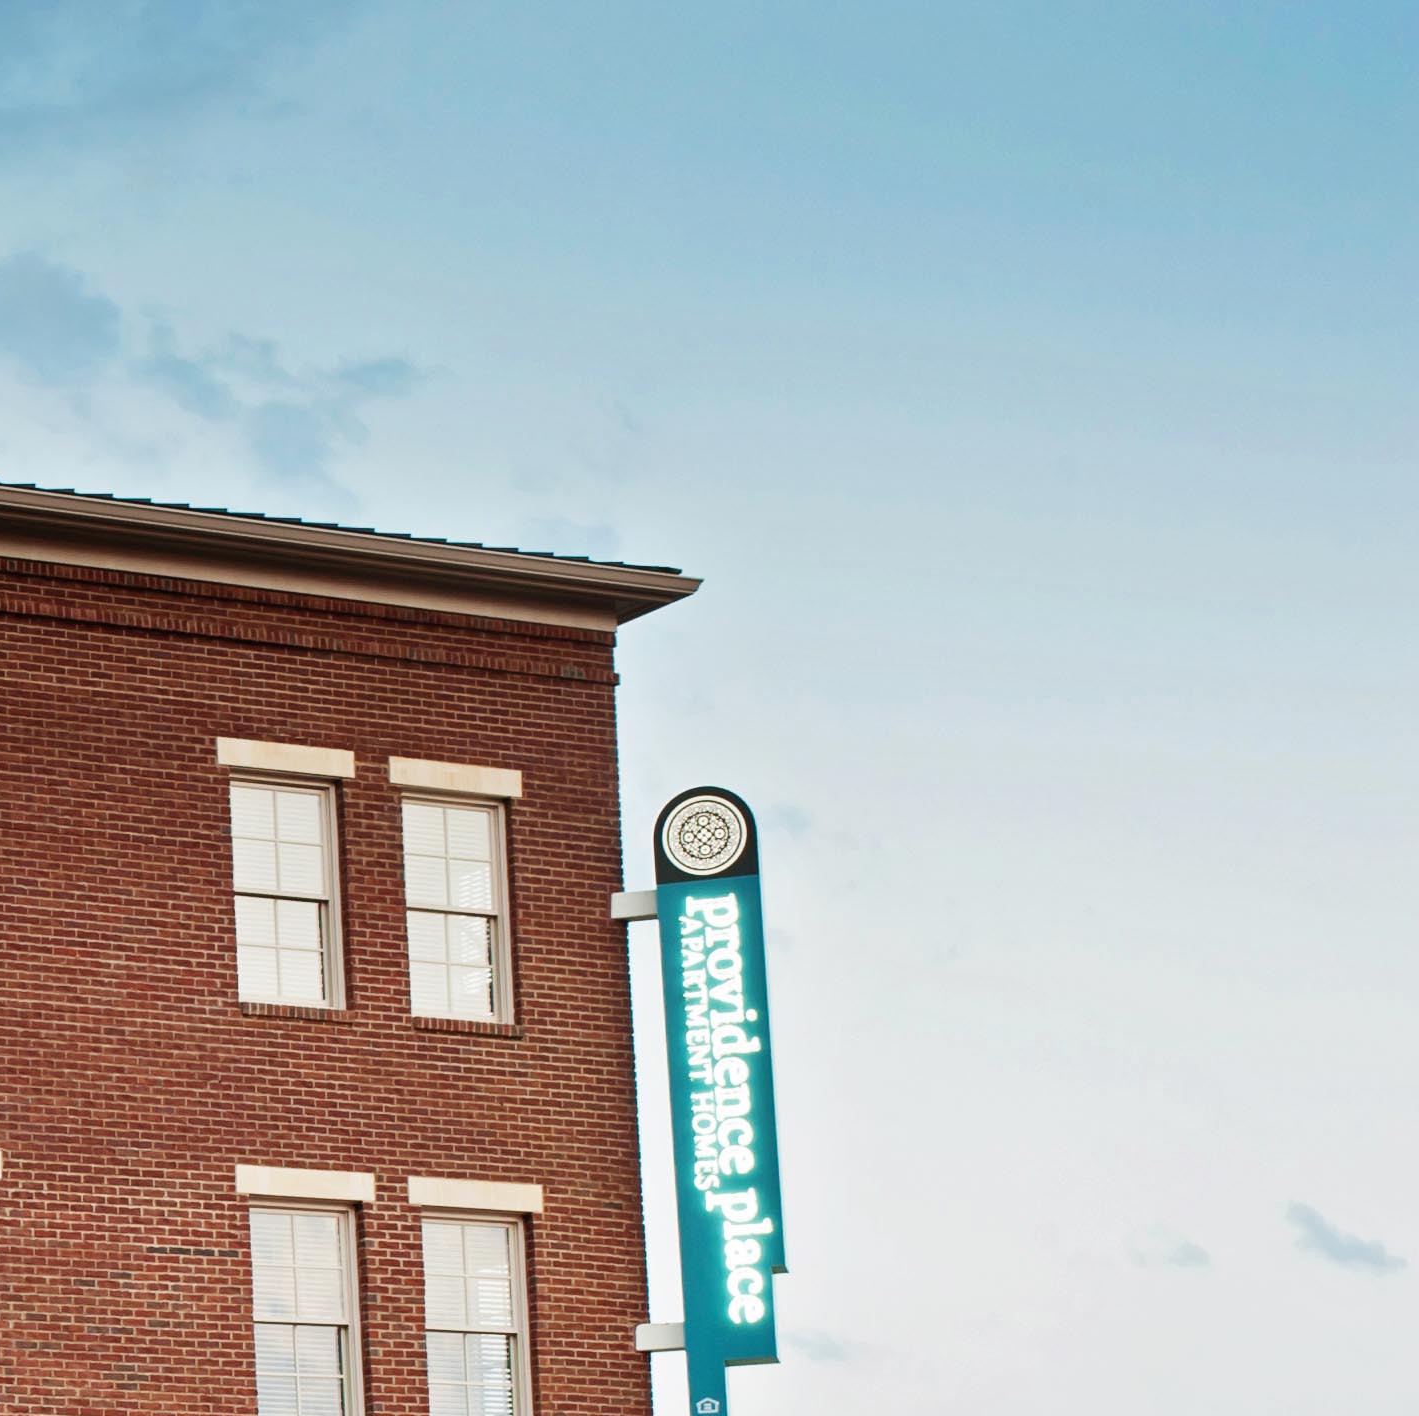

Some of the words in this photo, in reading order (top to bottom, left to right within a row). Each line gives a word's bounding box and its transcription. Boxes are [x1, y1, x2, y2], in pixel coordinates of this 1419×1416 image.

[678, 915, 714, 1085] APARTMENT
[685, 892, 762, 1176] providence
[689, 1090, 720, 1191] HOMES
[704, 1187, 773, 1325] place
